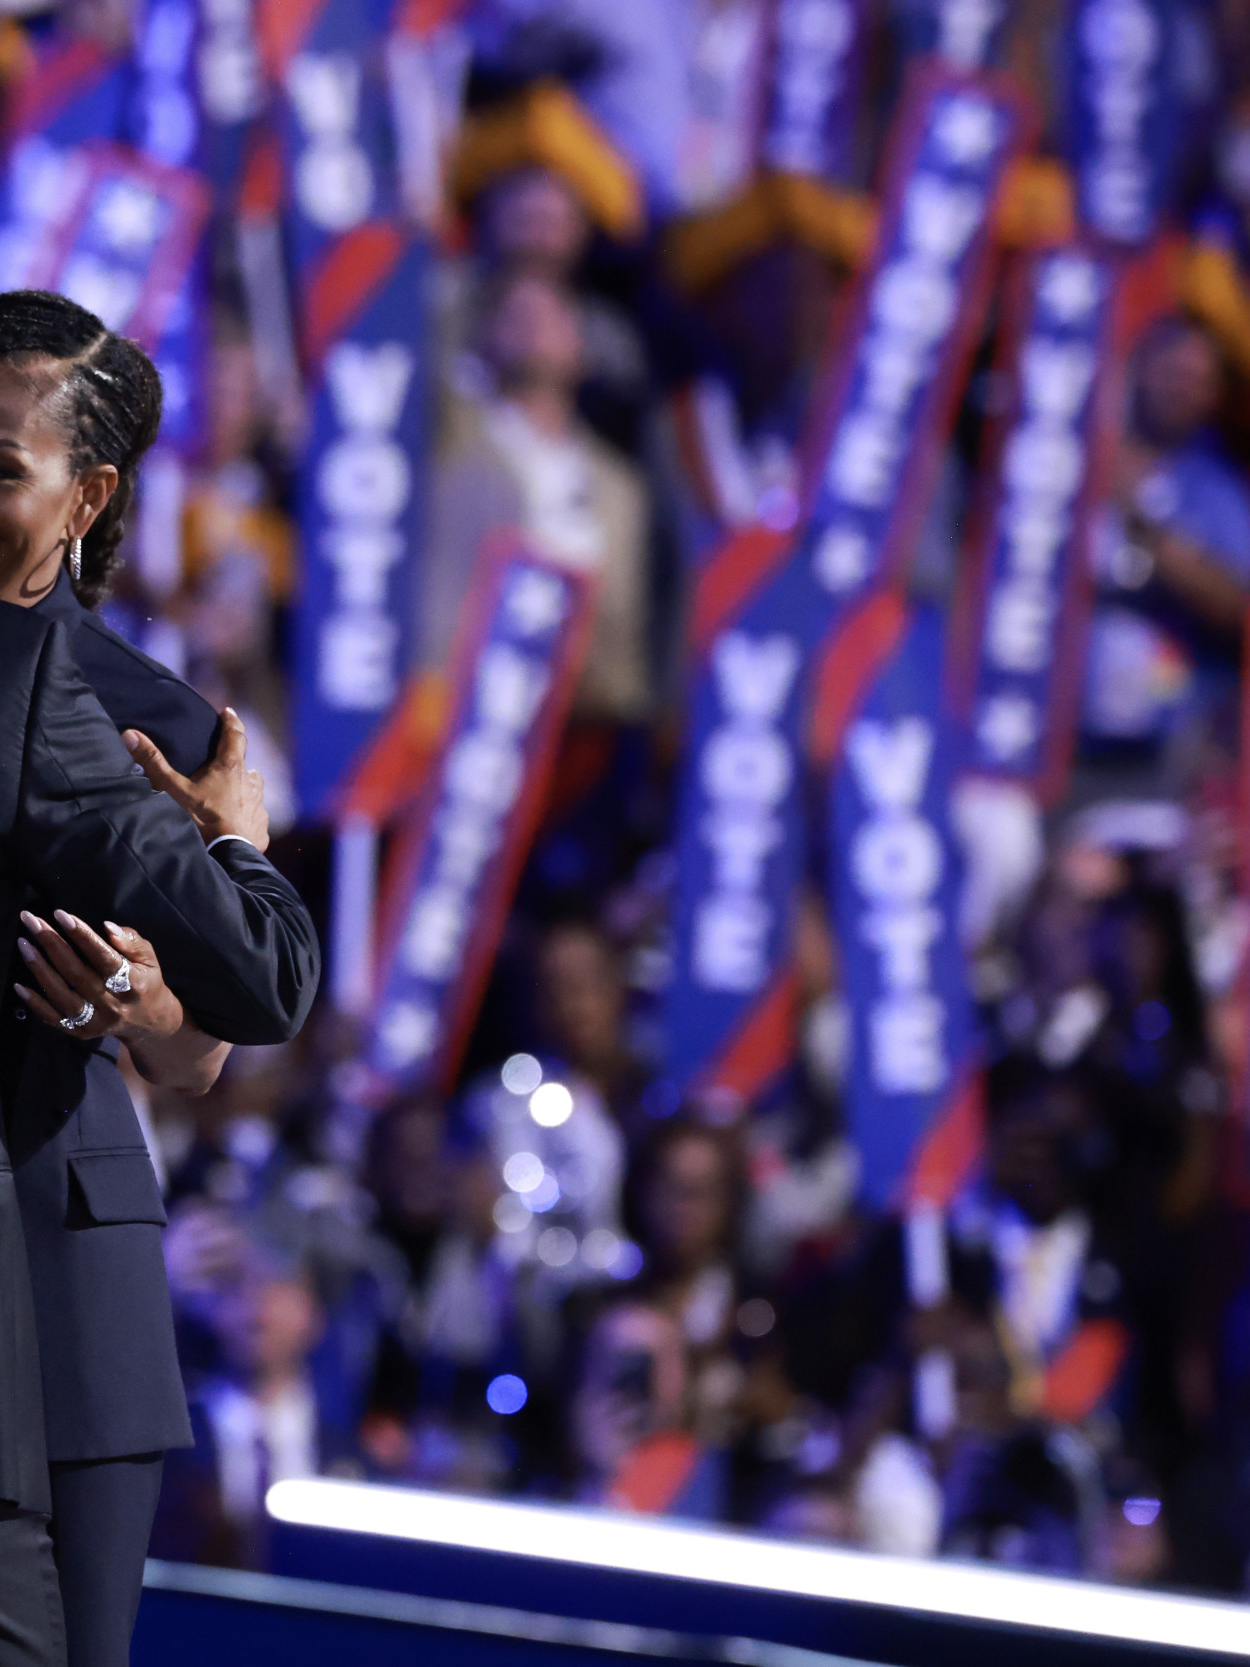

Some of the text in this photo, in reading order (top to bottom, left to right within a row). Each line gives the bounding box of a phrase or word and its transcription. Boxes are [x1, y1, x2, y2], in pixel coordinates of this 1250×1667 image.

[826, 172, 988, 509] VOTE
[984, 338, 1096, 674] VOTE
[316, 340, 415, 713] VOTE
[402, 640, 552, 982] VOTE
[692, 627, 802, 994] VOTE
[846, 714, 947, 1094] VOTE
